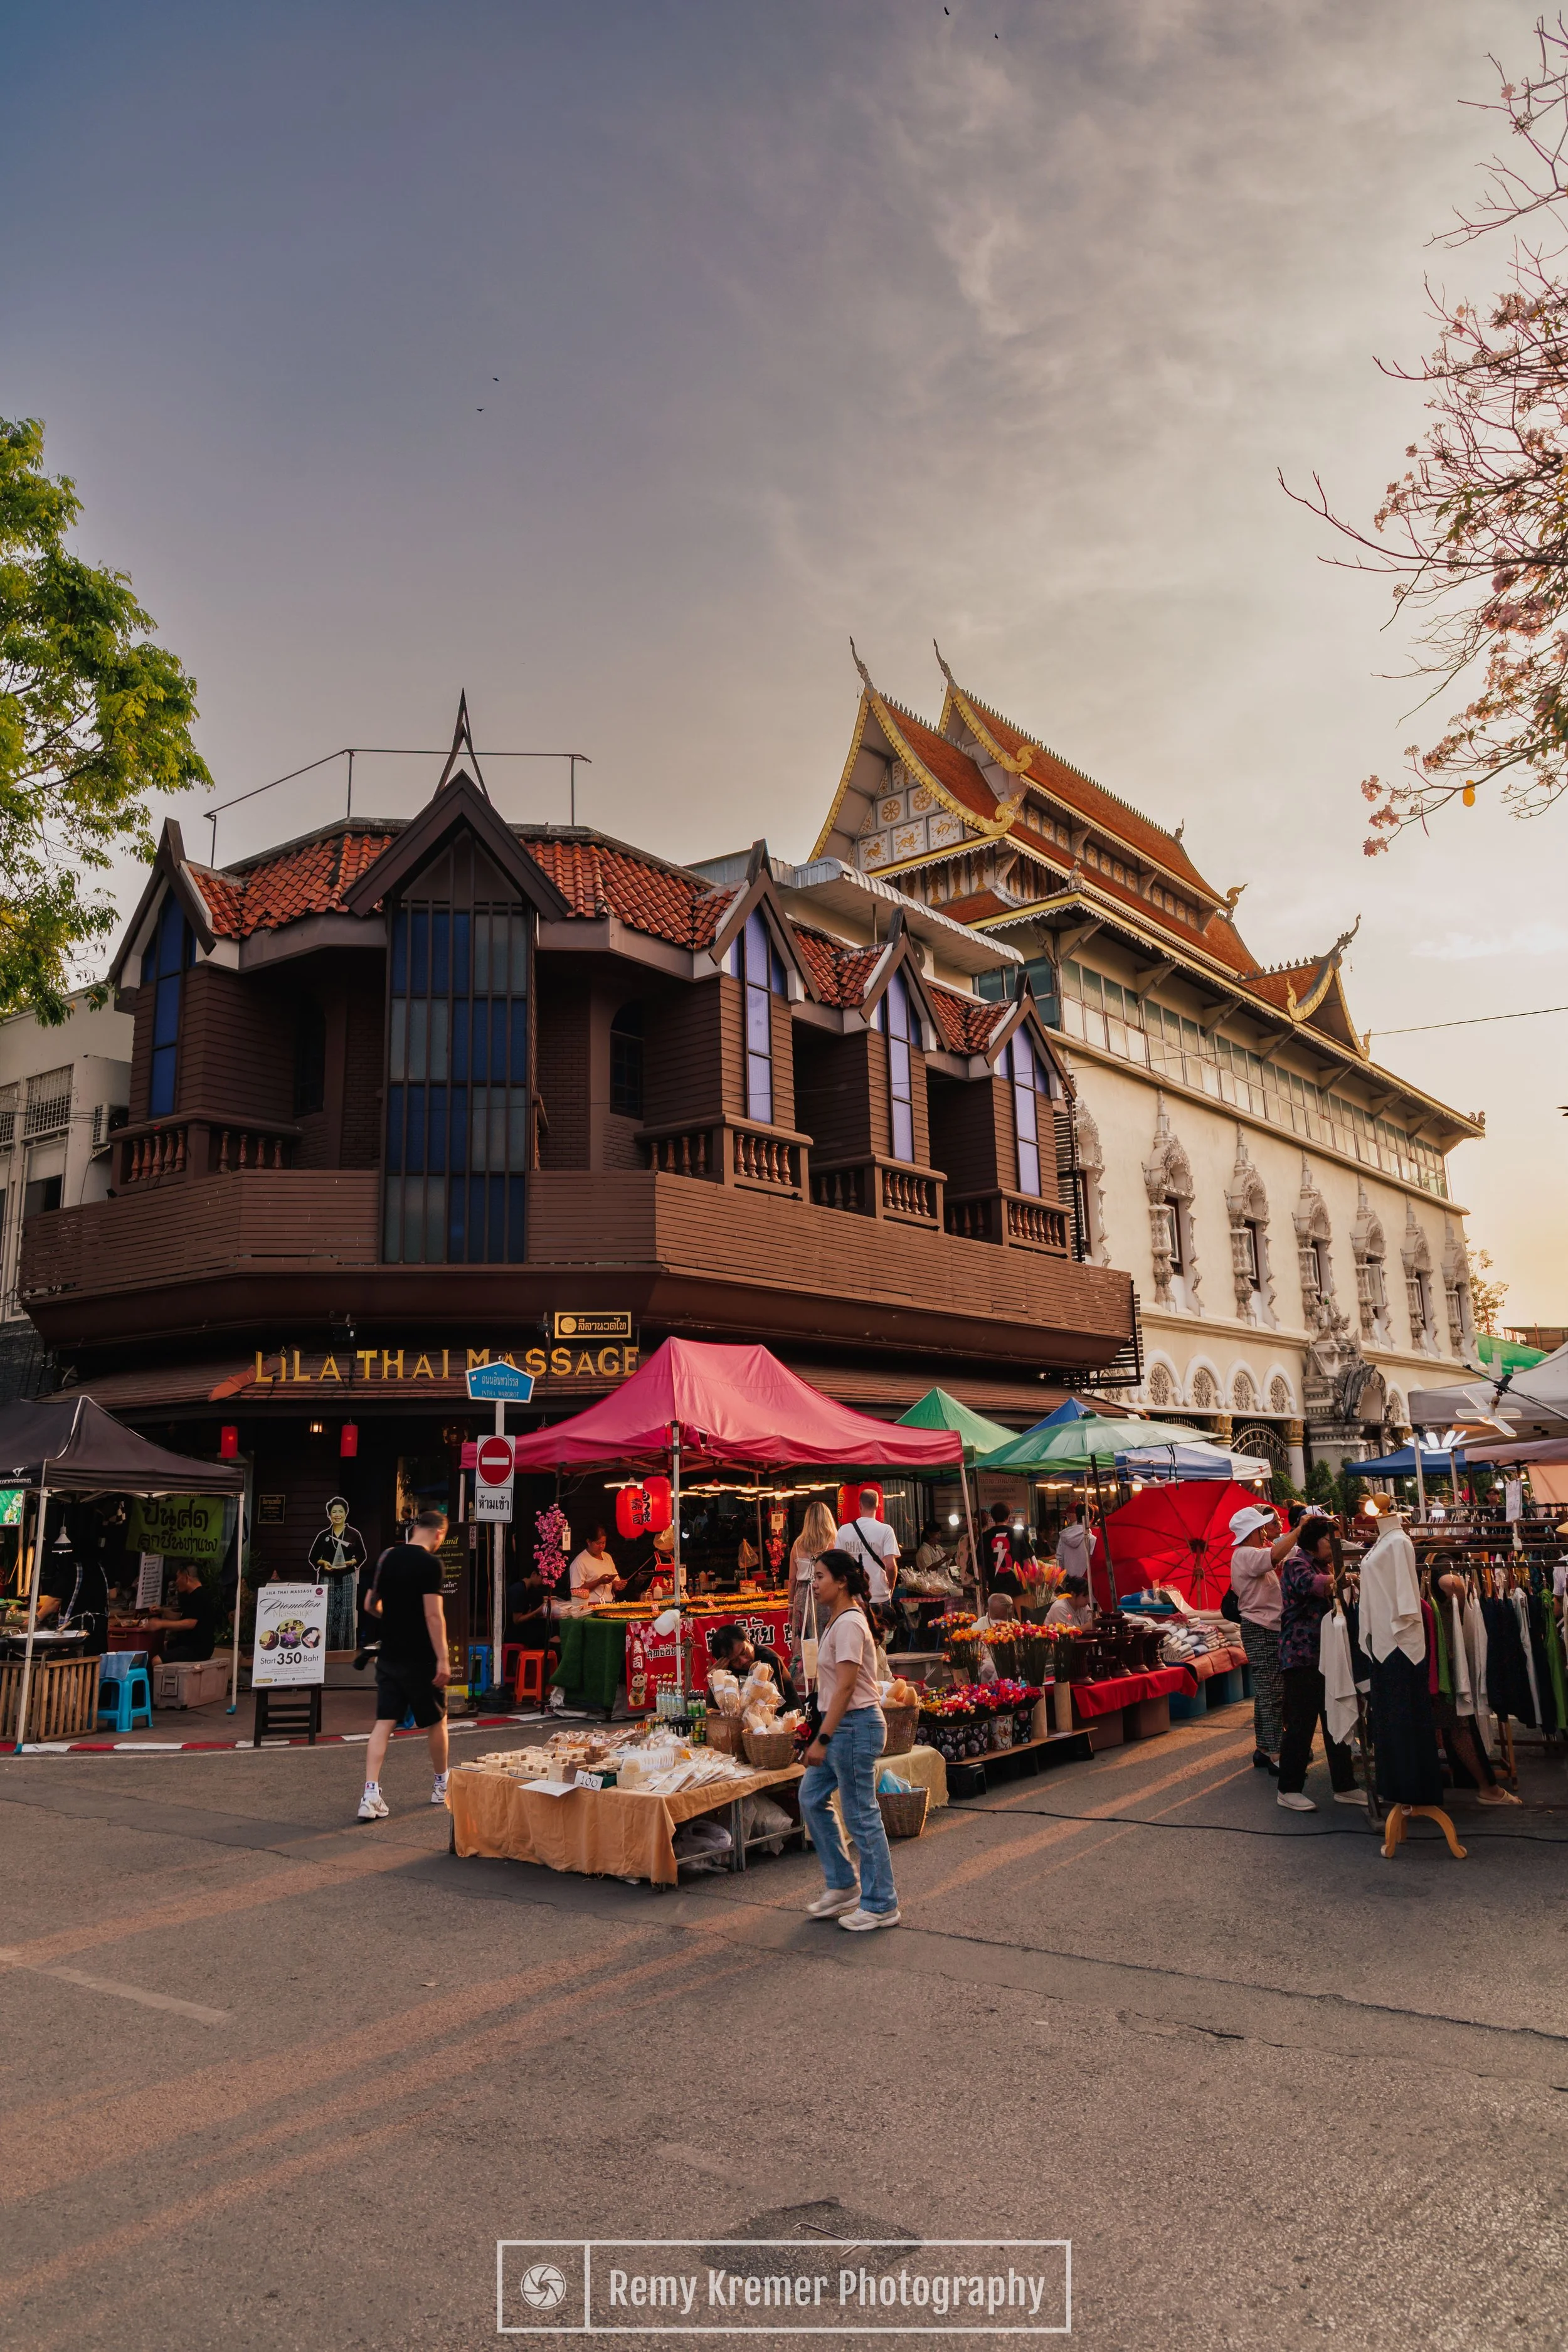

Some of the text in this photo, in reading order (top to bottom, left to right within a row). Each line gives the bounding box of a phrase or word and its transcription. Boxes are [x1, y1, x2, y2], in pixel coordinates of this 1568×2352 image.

[357, 1349, 449, 1380] THAI
[479, 1495, 509, 1510] ห้ามเข้า
[259, 1598, 321, 1615] Promotion
[273, 1609, 312, 1618] Massage
[277, 1652, 302, 1665] 350
[580, 1776, 598, 1788] 100
